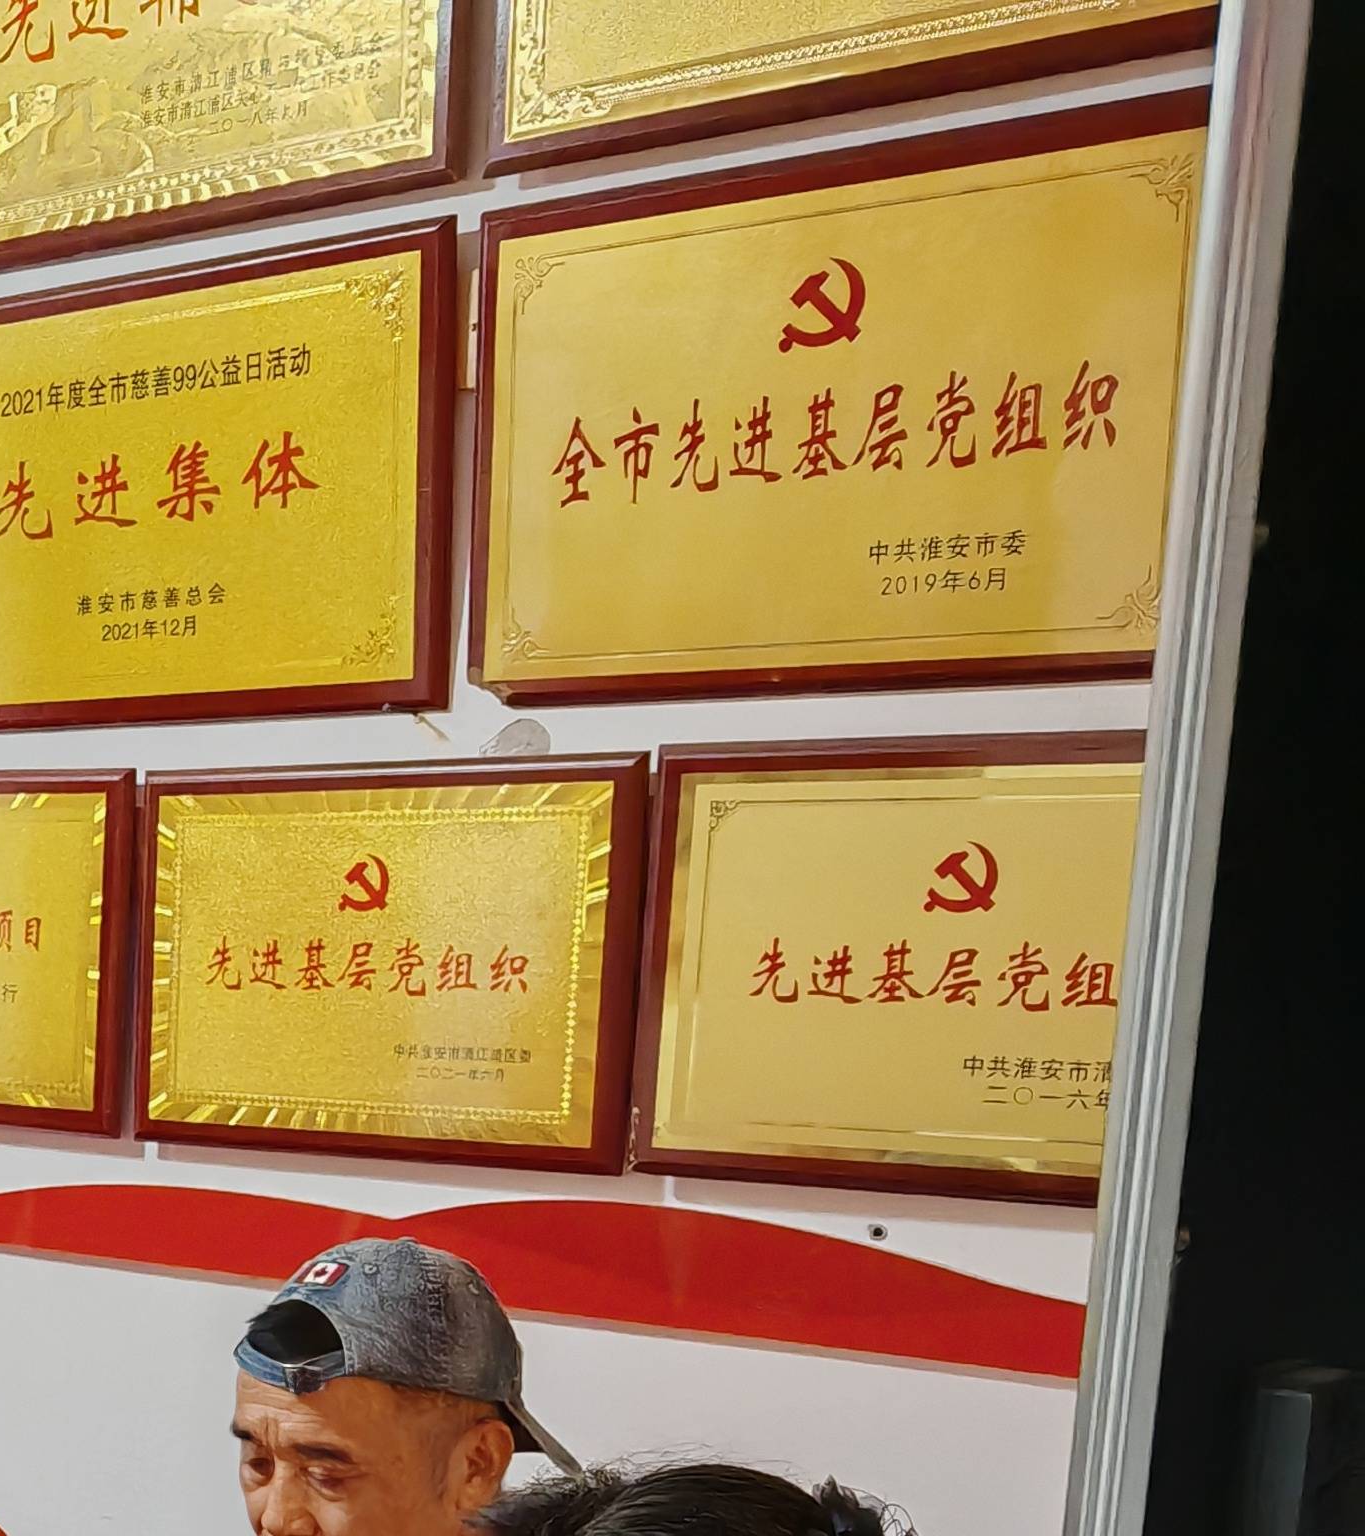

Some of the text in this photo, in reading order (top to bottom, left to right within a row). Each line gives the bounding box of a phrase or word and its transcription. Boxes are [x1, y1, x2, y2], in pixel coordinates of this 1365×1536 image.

[1, 343, 312, 419] 2021年度全市慈善99公益日活动
[551, 360, 1121, 509] 全市先进基层党组织
[868, 529, 1029, 566] 中共淮安市委
[76, 582, 227, 617] 淮安市慈善总会
[880, 568, 1008, 596] 2019年6月
[101, 616, 198, 643] 2021年12月
[205, 936, 531, 998] 先进基层党组织
[748, 936, 1119, 1013] 先进基层党组
